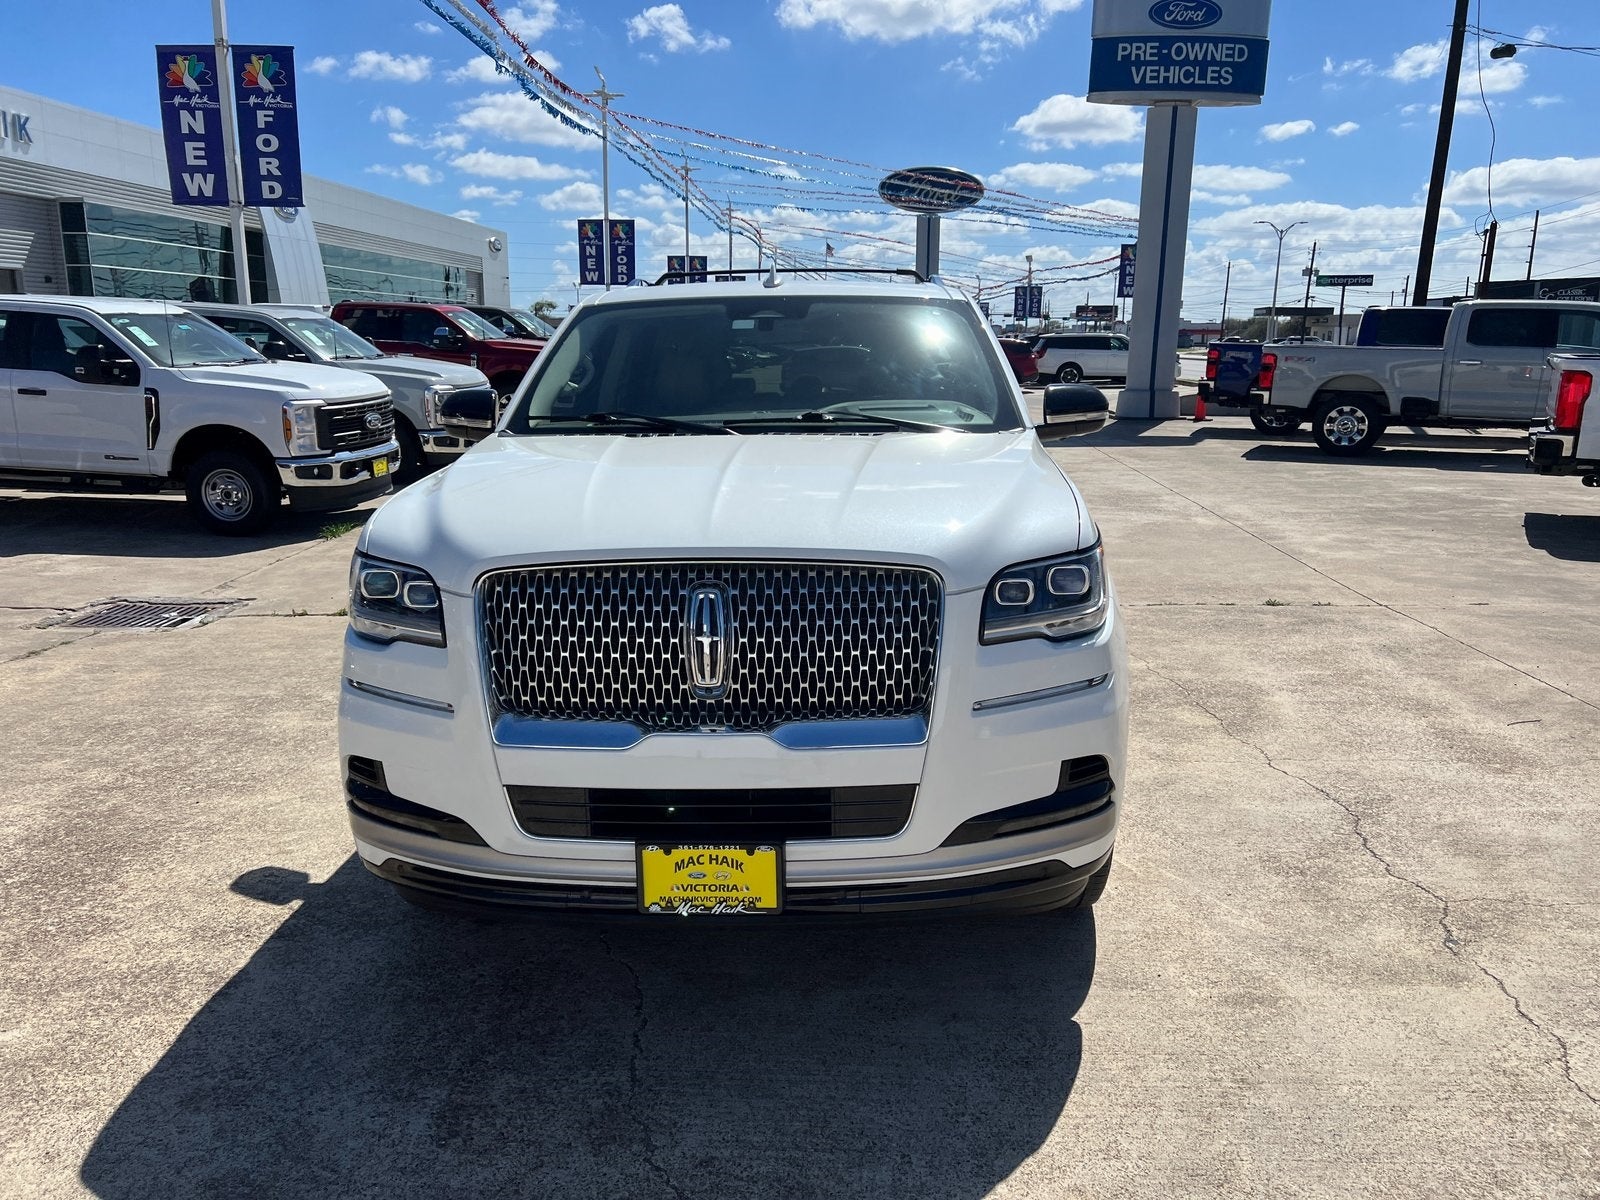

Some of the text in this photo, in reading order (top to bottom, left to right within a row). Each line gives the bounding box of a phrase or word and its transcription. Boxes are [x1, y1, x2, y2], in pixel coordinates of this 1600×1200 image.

[1164, 2, 1207, 21] Ford
[1131, 66, 1233, 85] VEHICLES
[179, 110, 214, 197] NEW
[255, 110, 283, 199] FORD
[585, 246, 599, 281] NEW
[617, 246, 628, 283] FORD
[1123, 265, 1135, 295] NEW
[1320, 276, 1373, 285] enterprise
[1016, 299, 1024, 317] NEW
[674, 854, 745, 873] MAC HAIK
[681, 883, 739, 892] VICTORIA
[658, 895, 762, 903] MACHAIKVICTORIA.COM
[675, 901, 747, 915] Mac Haik
